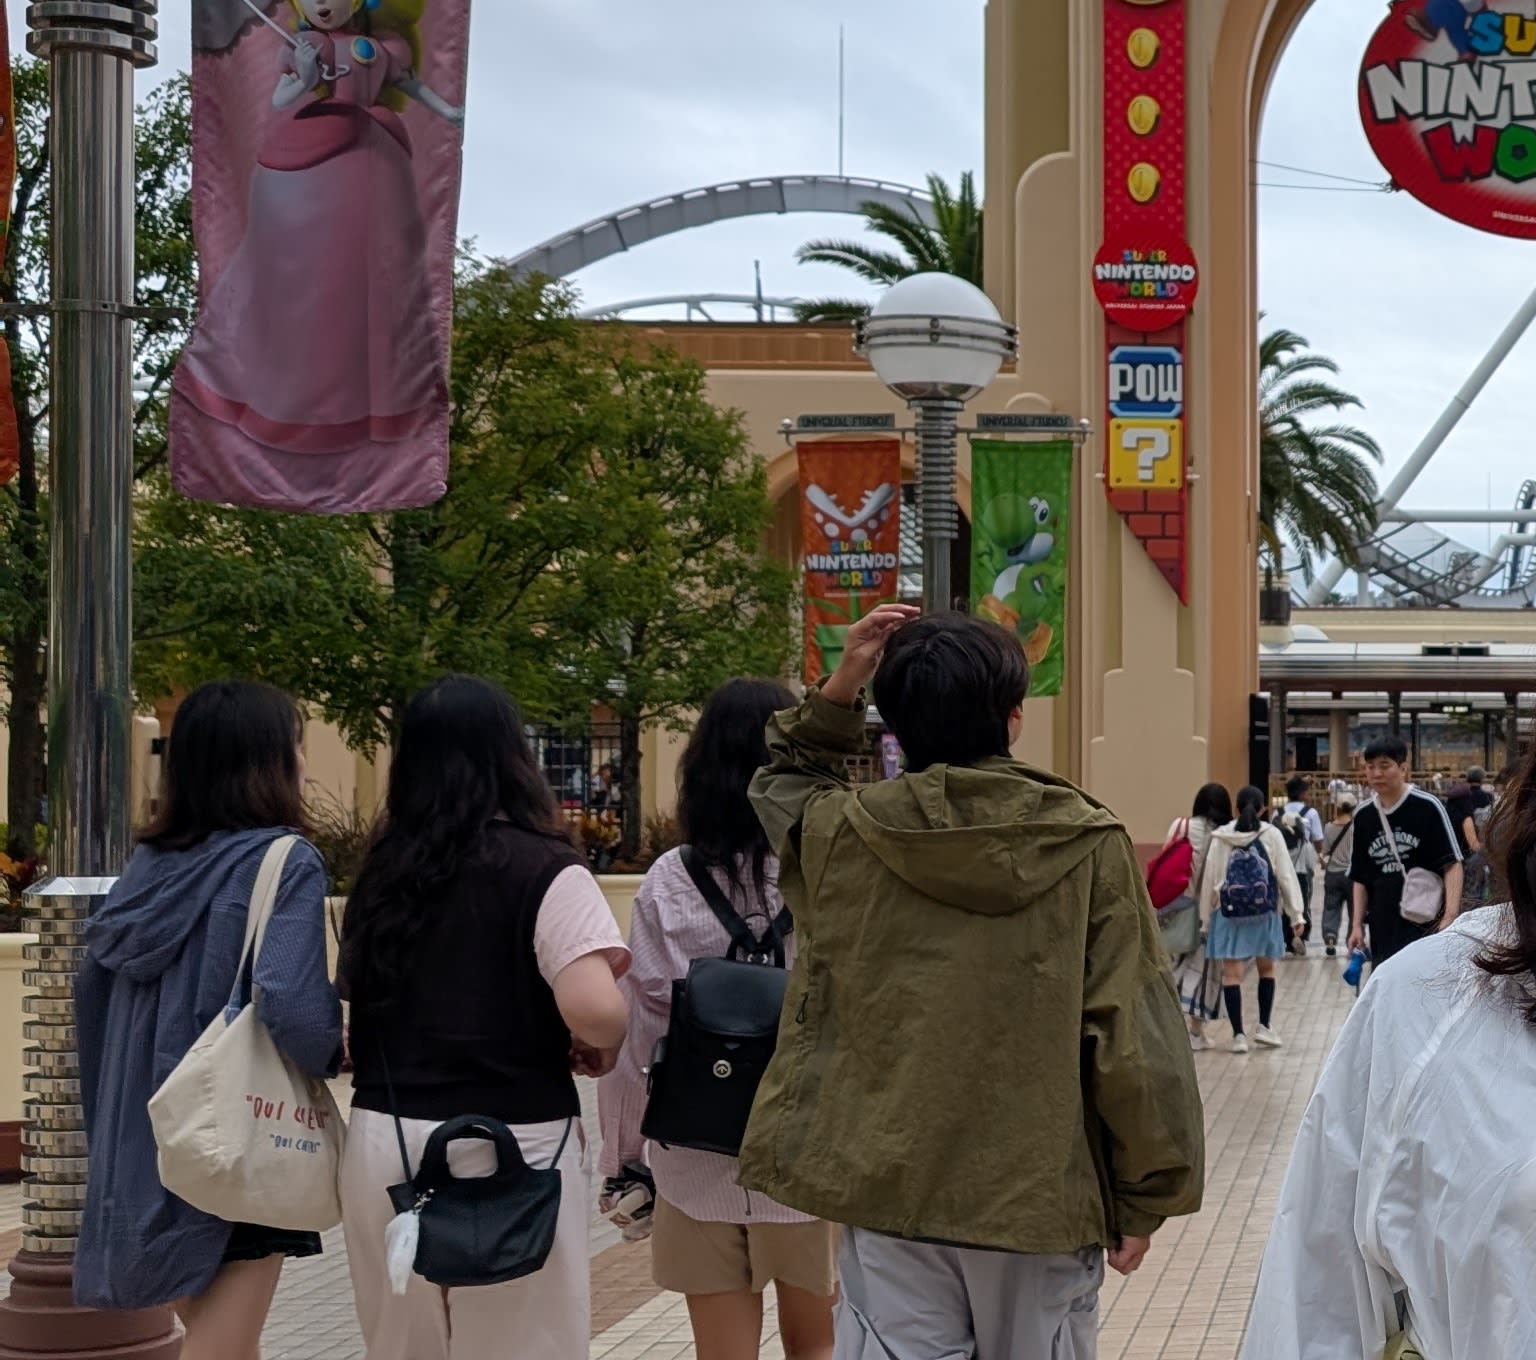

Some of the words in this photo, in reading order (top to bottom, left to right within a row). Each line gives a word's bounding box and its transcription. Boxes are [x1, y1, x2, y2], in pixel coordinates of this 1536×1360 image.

[1123, 250, 1167, 262] SUER
[1095, 263, 1195, 281] NINTENDO
[1109, 363, 1182, 402] POW
[831, 540, 873, 554] SUER
[806, 552, 897, 570] NINTENDO
